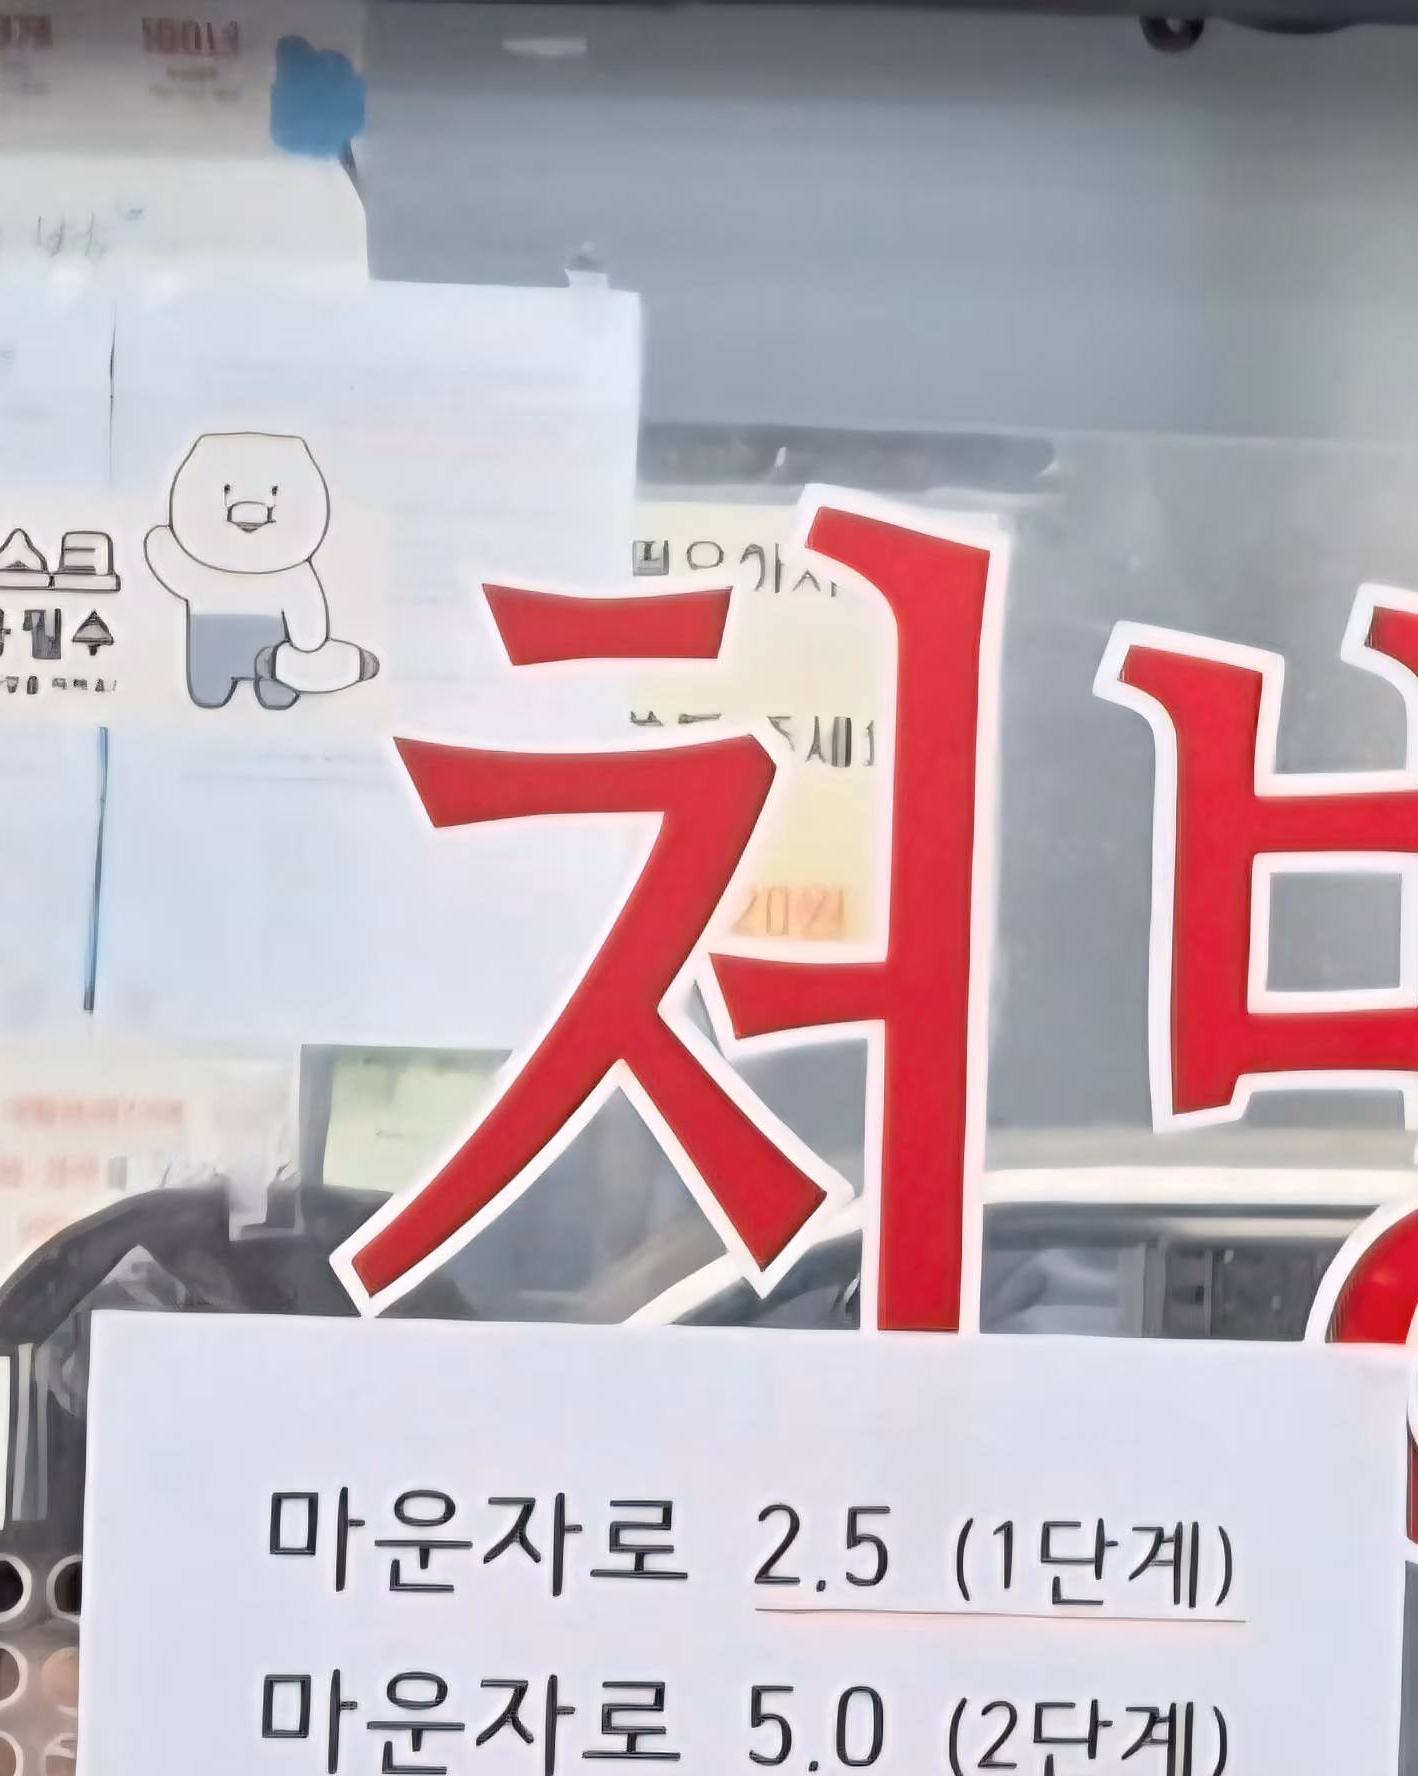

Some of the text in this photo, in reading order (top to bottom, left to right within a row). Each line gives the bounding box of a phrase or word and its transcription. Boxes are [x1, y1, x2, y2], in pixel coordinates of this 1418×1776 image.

[269, 1486, 1236, 1608] 마운자로 2.5 (1단계)
[748, 1685, 885, 1773] 5.0
